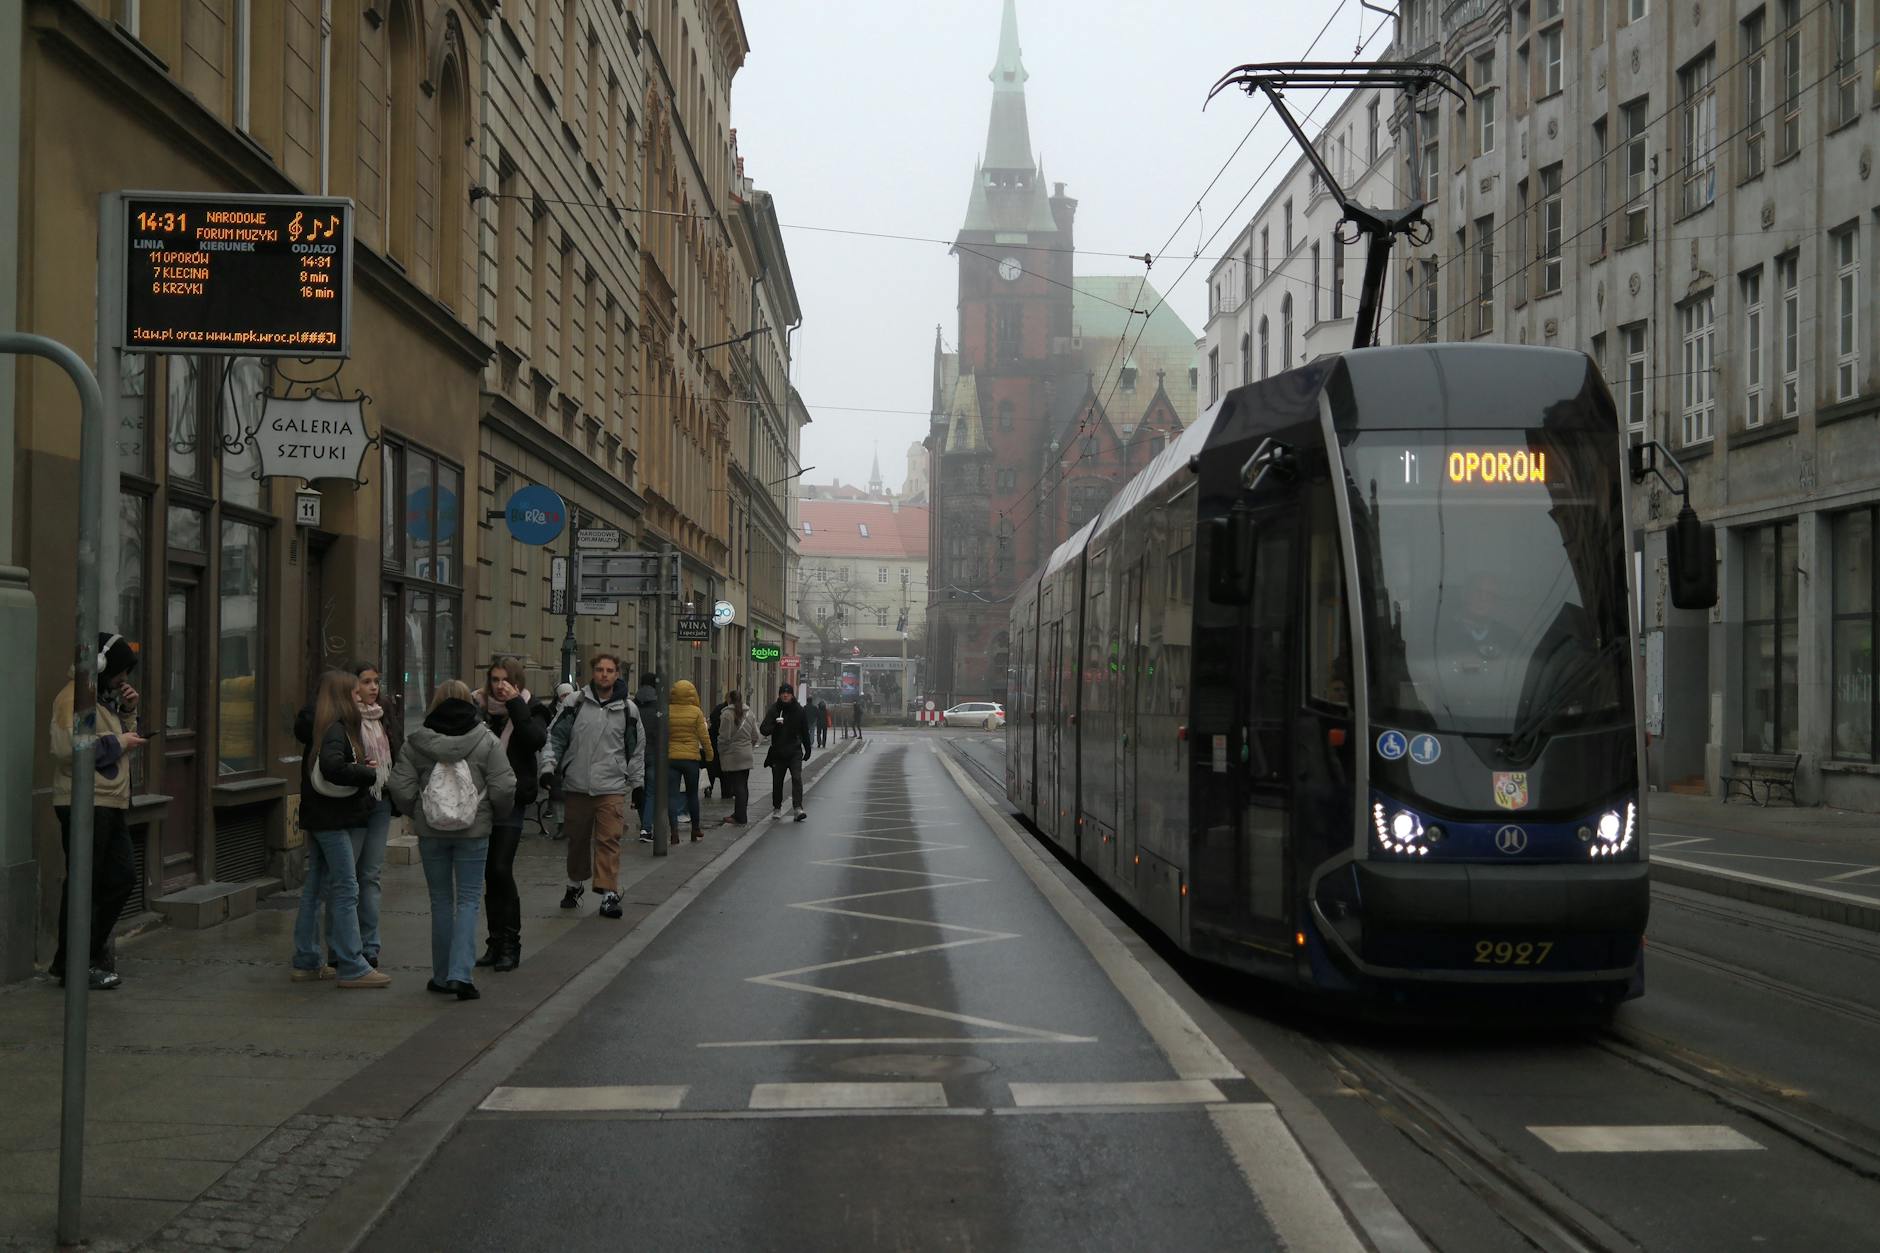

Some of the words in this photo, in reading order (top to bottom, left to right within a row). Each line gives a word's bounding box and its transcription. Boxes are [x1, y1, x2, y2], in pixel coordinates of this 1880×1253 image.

[137, 212, 187, 232] 14:31
[206, 212, 266, 225] NARODOWE
[196, 228, 234, 240] FORUM
[236, 229, 277, 242] MUZYKI
[134, 239, 165, 249] LINIA
[200, 241, 255, 252] KIERUNEK
[292, 243, 337, 254] ODJAZD
[150, 252, 161, 263] 11
[164, 252, 209, 264] OPORÓW
[300, 256, 331, 268] 14:31
[153, 267, 161, 278] 7
[163, 267, 209, 280] KLECINA
[300, 271, 308, 283] 8
[310, 272, 328, 283] min
[153, 282, 160, 294] 6
[162, 283, 203, 295] KRZYKI
[300, 286, 313, 298] 16
[315, 288, 334, 299] min
[176, 331, 203, 340] oraz
[272, 417, 353, 436] GALERIA
[277, 444, 347, 460] SZTUKI
[1449, 450, 1545, 482] OPORÓW
[302, 503, 314, 517] 11
[680, 621, 707, 630] WINA
[751, 647, 779, 657] żabka
[1474, 940, 1554, 966] 2927
